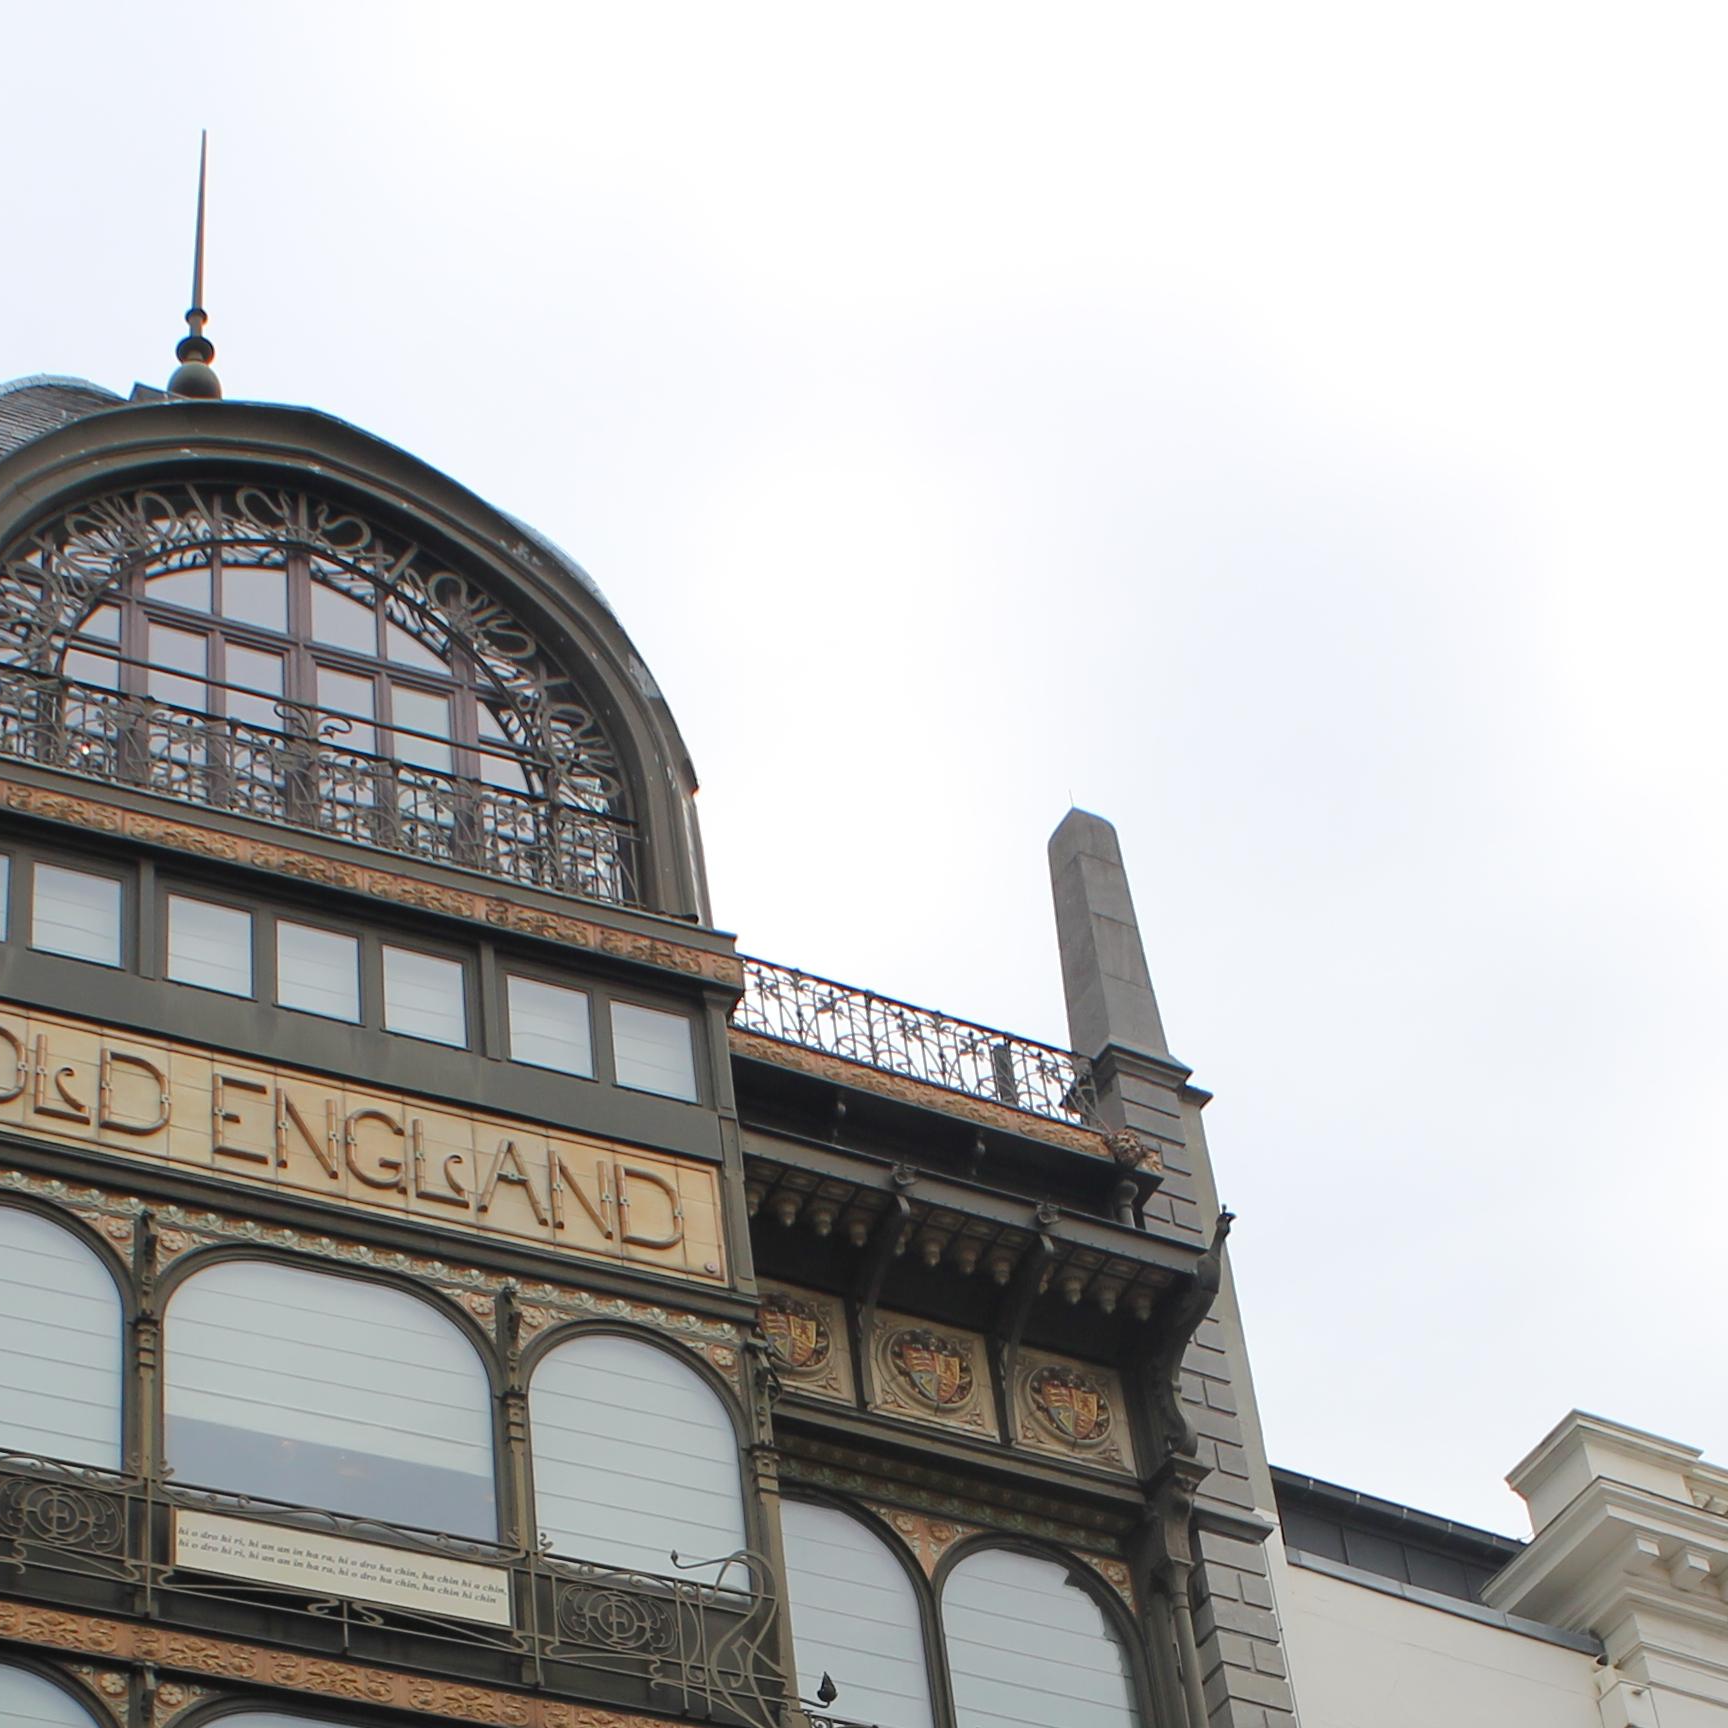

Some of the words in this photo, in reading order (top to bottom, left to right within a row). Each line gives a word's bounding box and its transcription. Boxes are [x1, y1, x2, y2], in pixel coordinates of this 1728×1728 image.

[213, 1073, 683, 1250] ENGLAND
[179, 1527, 189, 1536] hi
[201, 1532, 218, 1541] dro
[221, 1533, 232, 1543] hi
[249, 1539, 259, 1548] hi
[306, 1550, 319, 1559] ha
[338, 1554, 348, 1564] hi
[360, 1559, 377, 1570] dro
[437, 1575, 459, 1585] chin
[461, 1579, 472, 1588] hi
[179, 1539, 189, 1547] hi
[201, 1543, 218, 1553] dro
[221, 1545, 232, 1555] hi
[249, 1550, 260, 1560] hi
[306, 1562, 319, 1571] ha
[338, 1566, 348, 1576] hi
[360, 1571, 377, 1581] dro
[437, 1587, 459, 1597] chin
[462, 1590, 473, 1599] hi
[474, 1594, 497, 1604] chin
